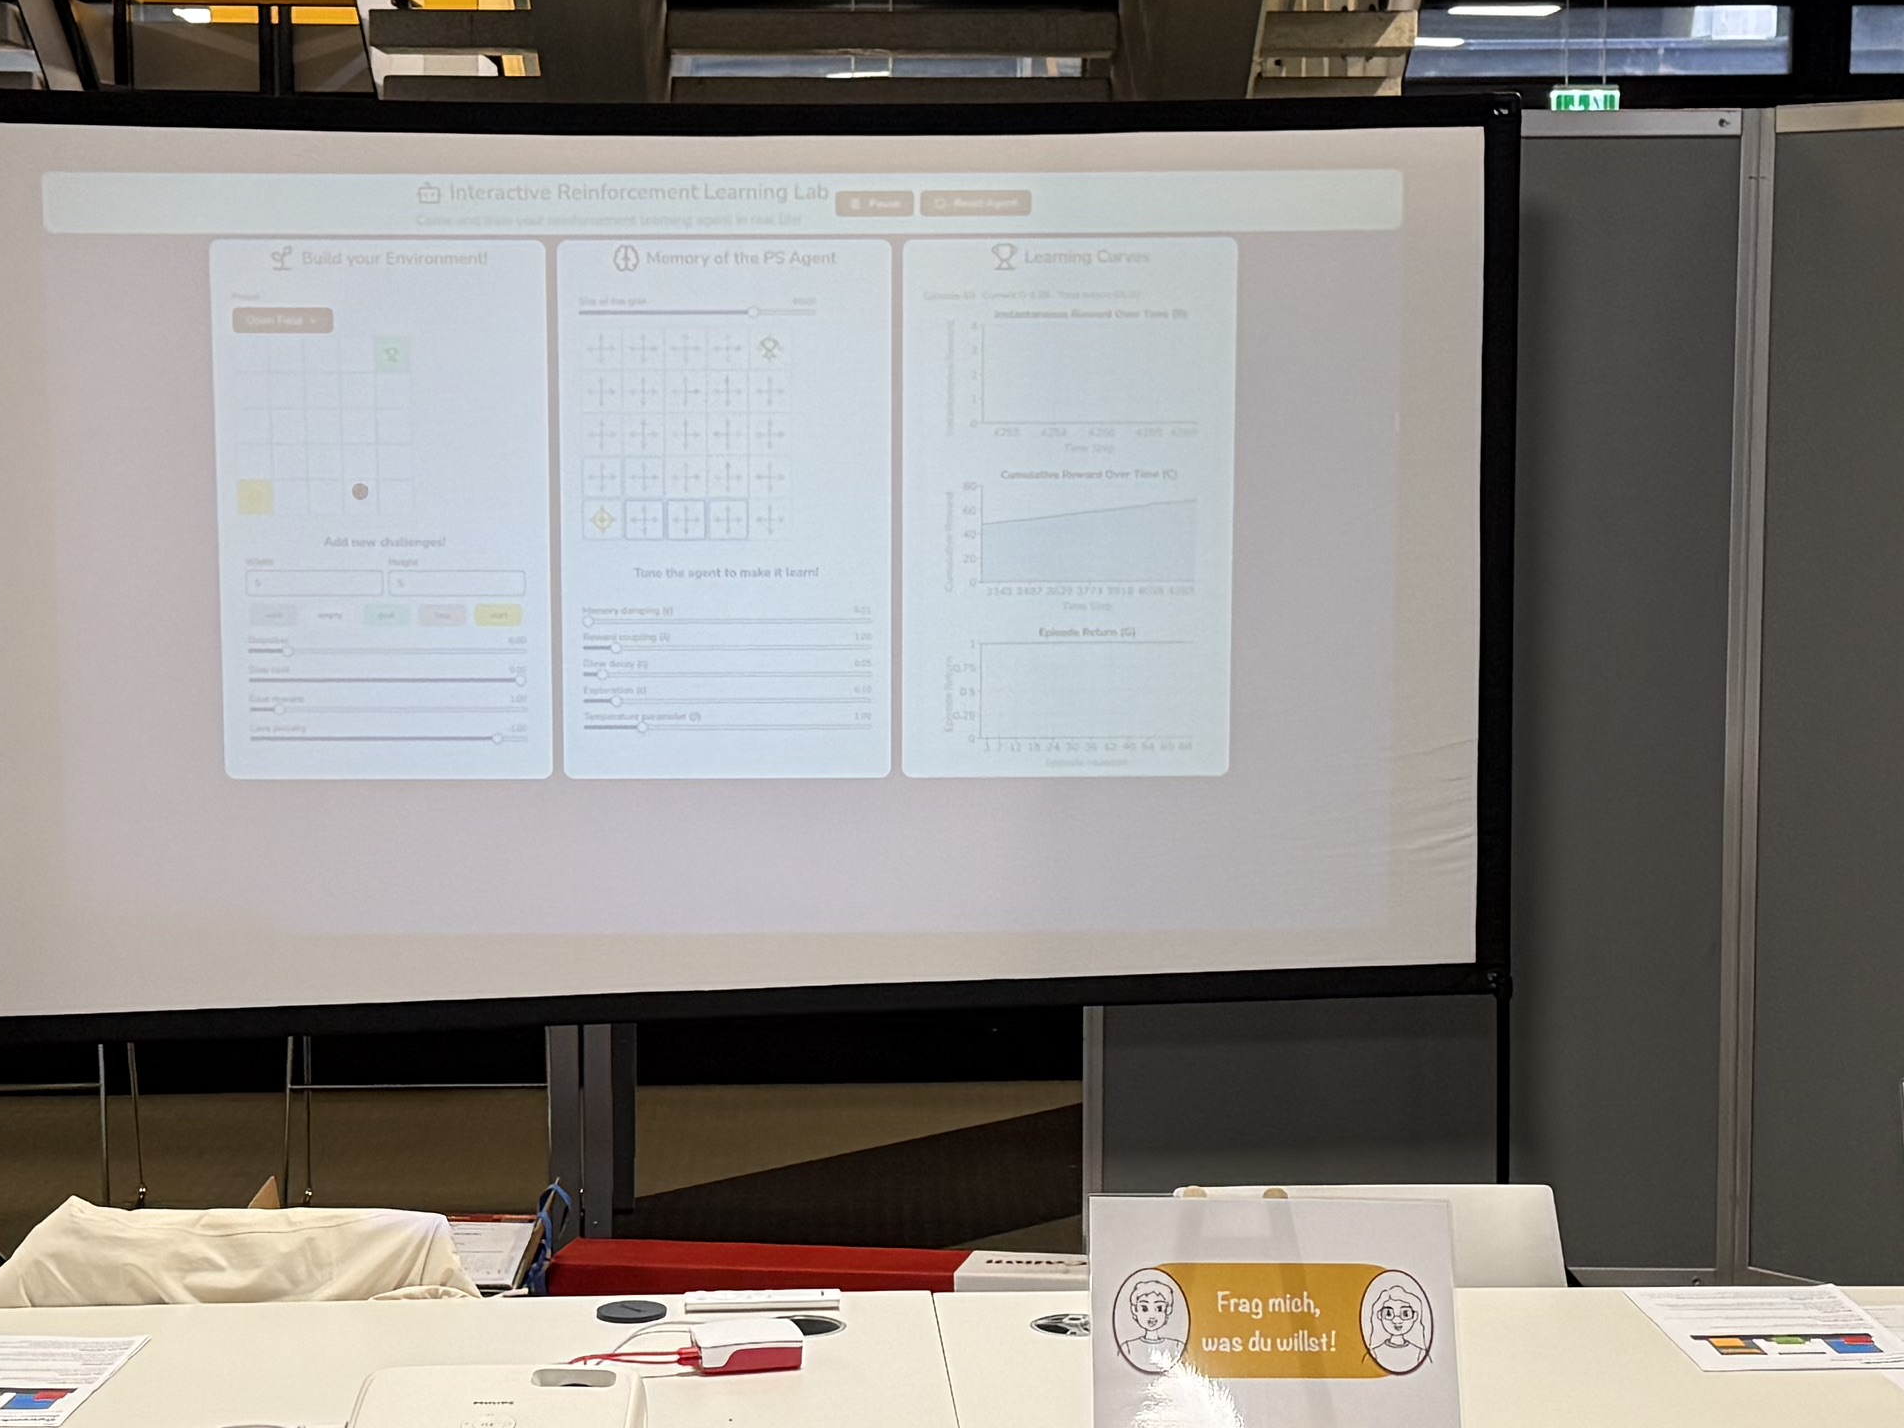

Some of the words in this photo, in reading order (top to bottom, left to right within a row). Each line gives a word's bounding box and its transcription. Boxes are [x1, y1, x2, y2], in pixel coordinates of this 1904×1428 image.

[450, 184, 550, 201] Interactive
[557, 184, 698, 201] Reinforcement
[704, 184, 788, 204] Learning
[794, 184, 829, 201] Lab
[302, 252, 342, 266] Build
[348, 254, 380, 267] your
[386, 252, 488, 266] Environment!
[646, 251, 709, 267] Memory
[714, 251, 730, 264] of
[734, 251, 759, 264] the
[764, 252, 785, 264] PS
[790, 251, 836, 267] Agent
[1024, 250, 1093, 266] Learning
[1097, 250, 1151, 264] Curves
[324, 537, 348, 548] Add
[351, 538, 376, 548] new
[380, 536, 446, 549] challenges!
[635, 567, 663, 579] Tune
[666, 567, 685, 578] the
[688, 568, 721, 580] agent
[724, 568, 737, 578] to
[740, 567, 771, 578] make
[774, 567, 782, 578] it
[785, 566, 819, 578] learn!
[1217, 1290, 1263, 1318] Frag
[1268, 1291, 1321, 1316] mich,
[1201, 1336, 1242, 1353] was
[1248, 1330, 1272, 1353] du
[1276, 1329, 1337, 1353] willst!
